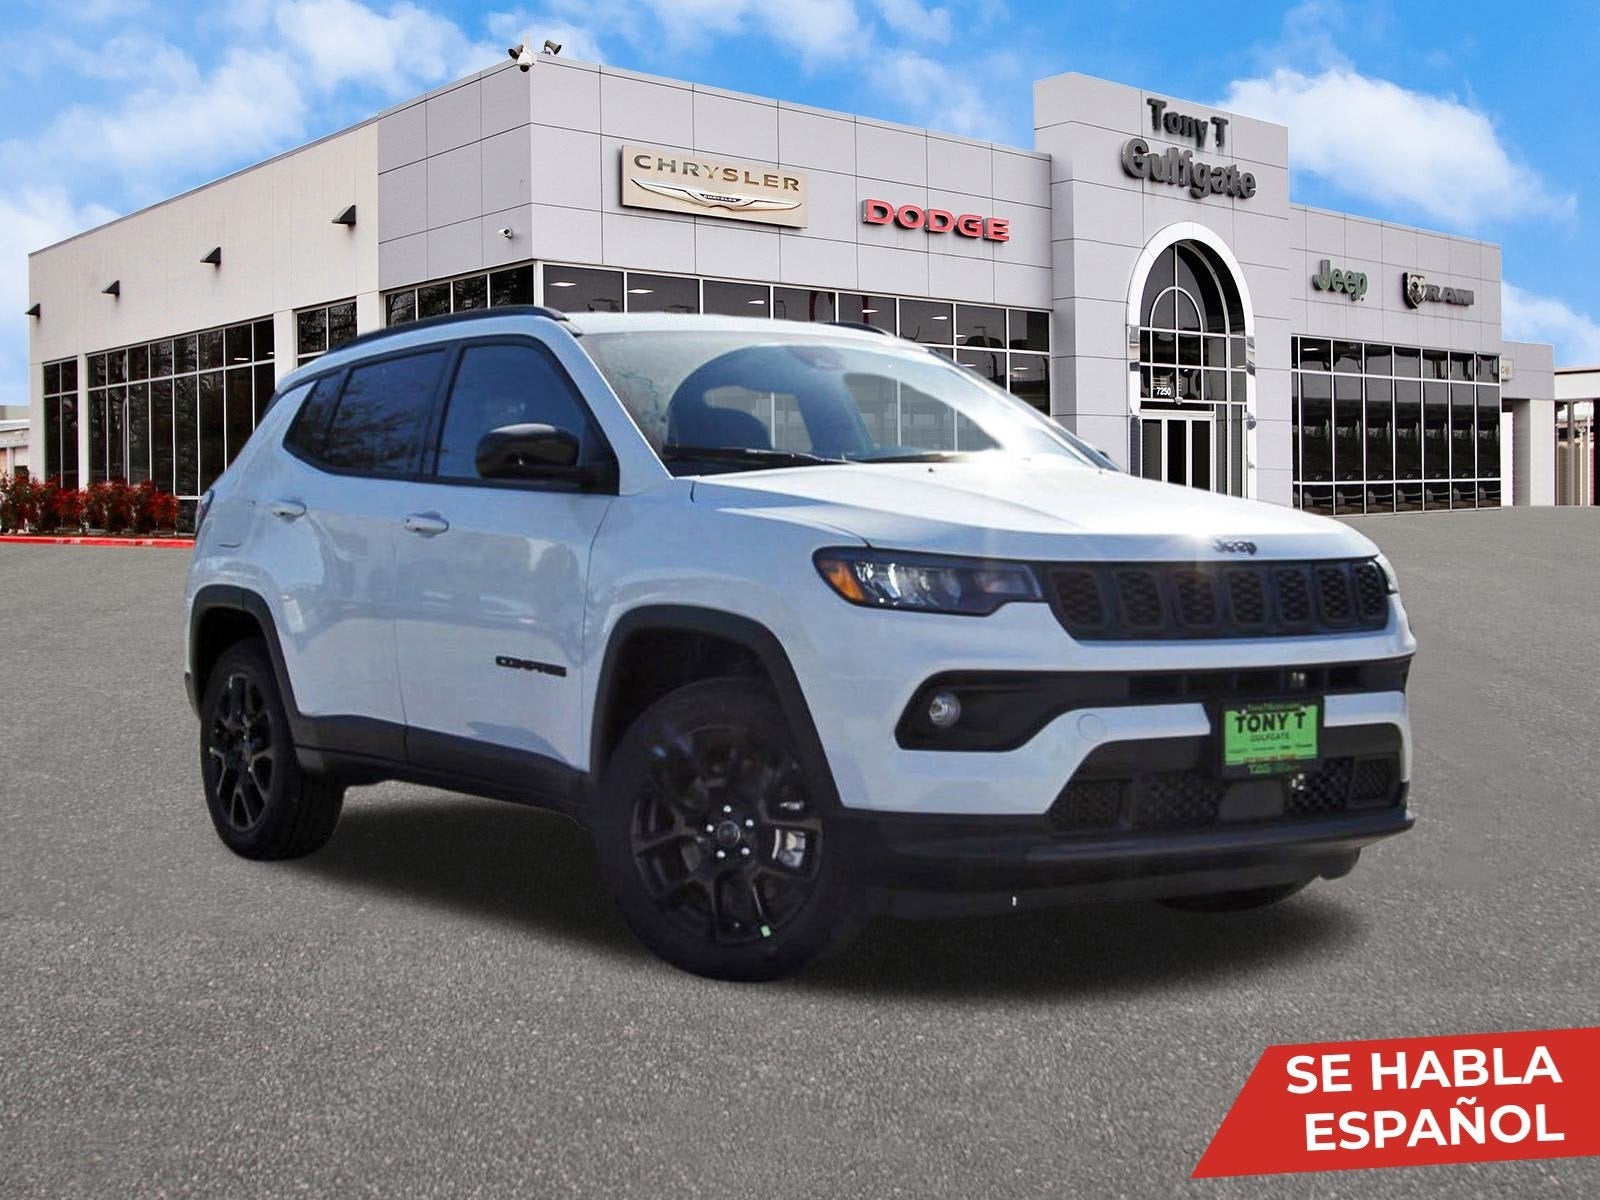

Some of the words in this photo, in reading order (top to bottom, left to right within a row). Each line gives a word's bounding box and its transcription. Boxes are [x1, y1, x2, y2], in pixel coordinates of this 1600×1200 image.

[1146, 98, 1208, 148] Tony
[1210, 116, 1229, 147] T
[634, 154, 800, 192] CHRYSLER
[1121, 137, 1257, 199] Gulfgate
[862, 199, 1010, 242] DODGE
[1312, 259, 1368, 301] Jeep
[1425, 284, 1475, 307] RAM
[1156, 387, 1172, 396] 7250
[1235, 713, 1288, 734] TONY
[1294, 711, 1306, 730] T
